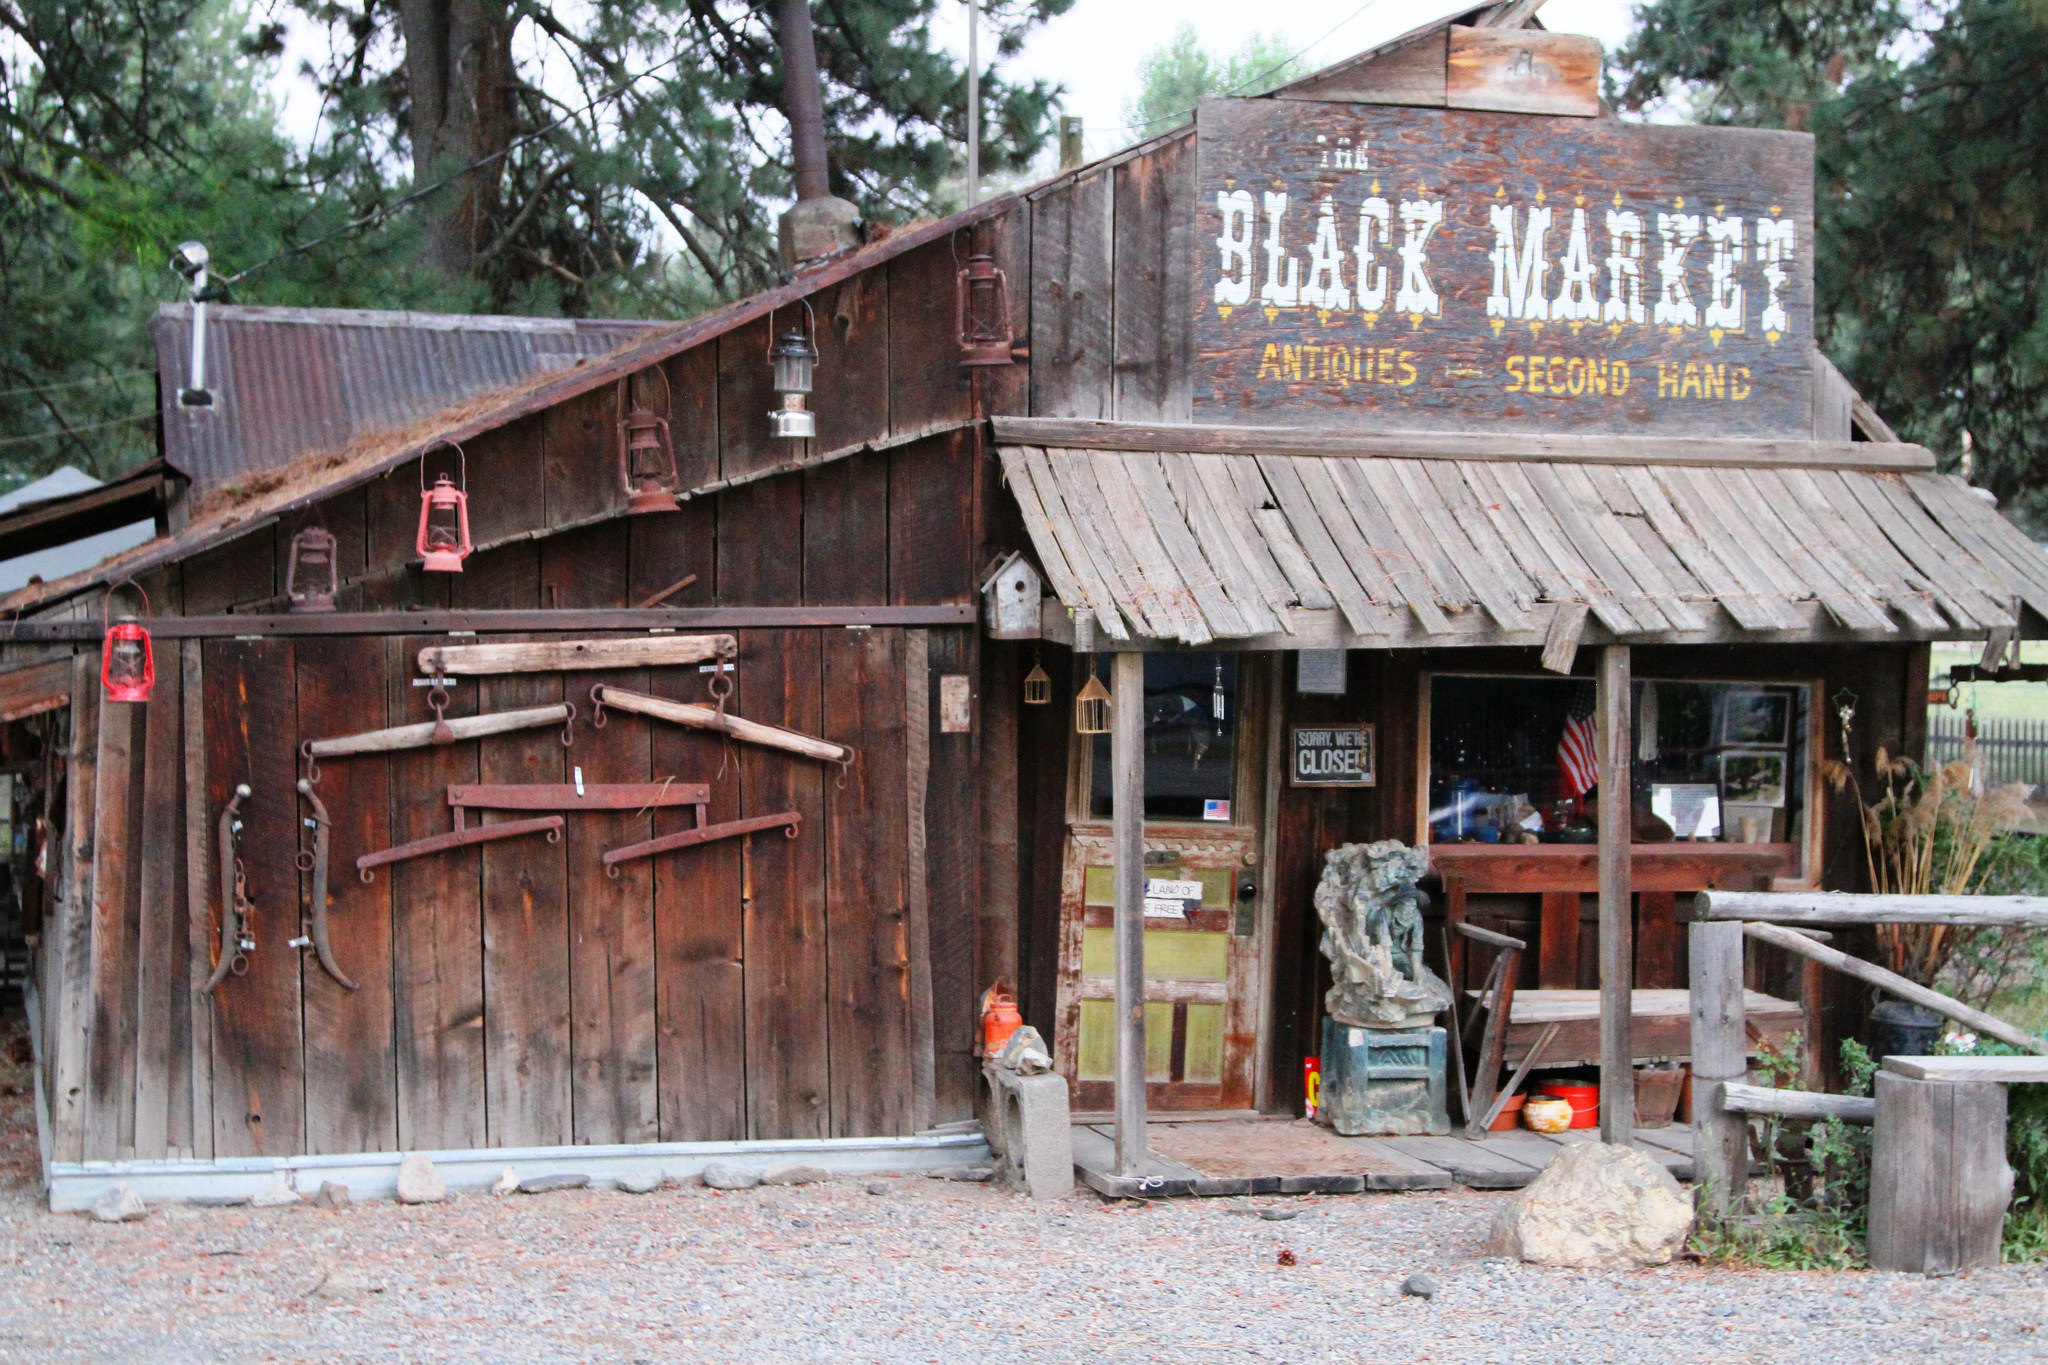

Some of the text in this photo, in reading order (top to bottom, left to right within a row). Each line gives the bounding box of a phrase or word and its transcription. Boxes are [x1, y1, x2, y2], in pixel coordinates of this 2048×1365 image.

[1316, 134, 1369, 171] THE
[1213, 189, 1796, 333] BLACK MARKET
[1256, 343, 1752, 401] ANTIQUES SECOND HAND
[1298, 731, 1368, 747] SORRY, WE'RE
[1299, 749, 1367, 775] CLOSED
[1153, 884, 1196, 896] LAND OF
[1154, 903, 1180, 915] FREE
